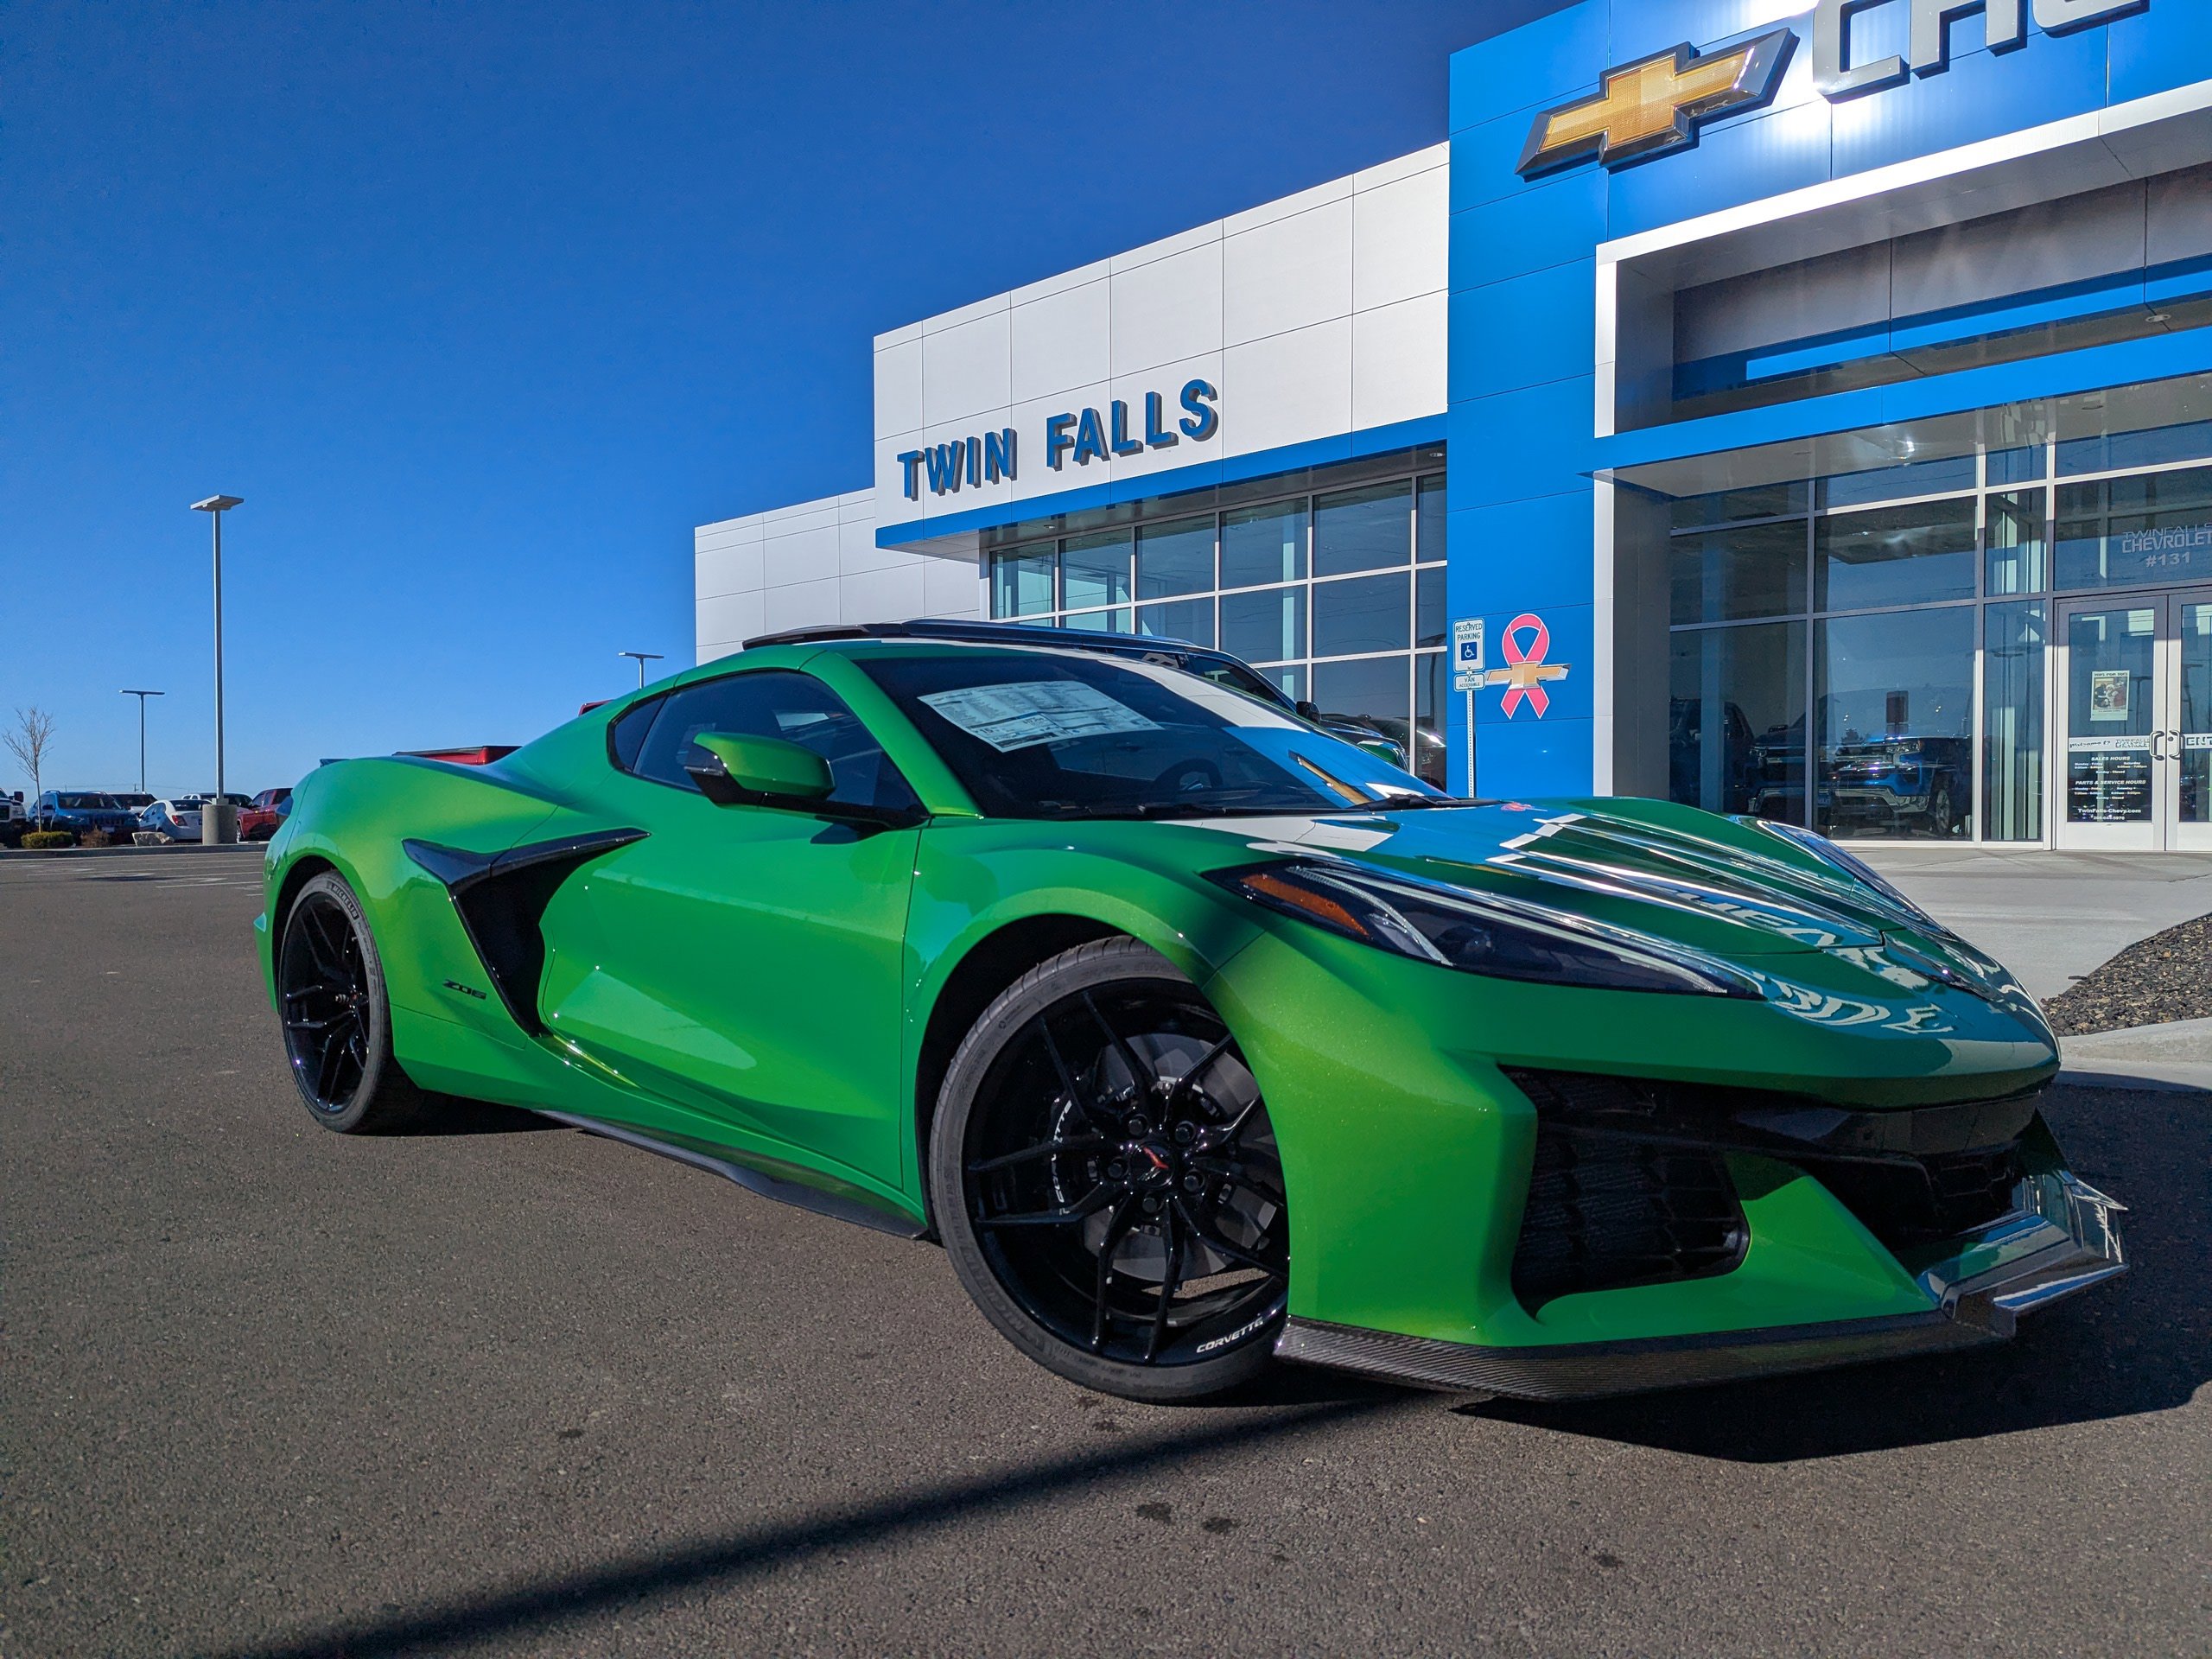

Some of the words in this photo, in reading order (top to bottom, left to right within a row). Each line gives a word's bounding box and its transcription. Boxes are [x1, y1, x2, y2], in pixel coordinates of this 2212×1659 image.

[897, 427, 1018, 503] TWIN
[1046, 378, 1219, 473] FALLS
[2145, 551, 2192, 569] #131
[1455, 623, 1483, 632] RESERVED
[1457, 632, 1481, 641] PARKING
[331, 883, 359, 919] MICHELIN
[442, 977, 487, 1001] Z06
[1196, 1316, 1265, 1354] CORVETTE
